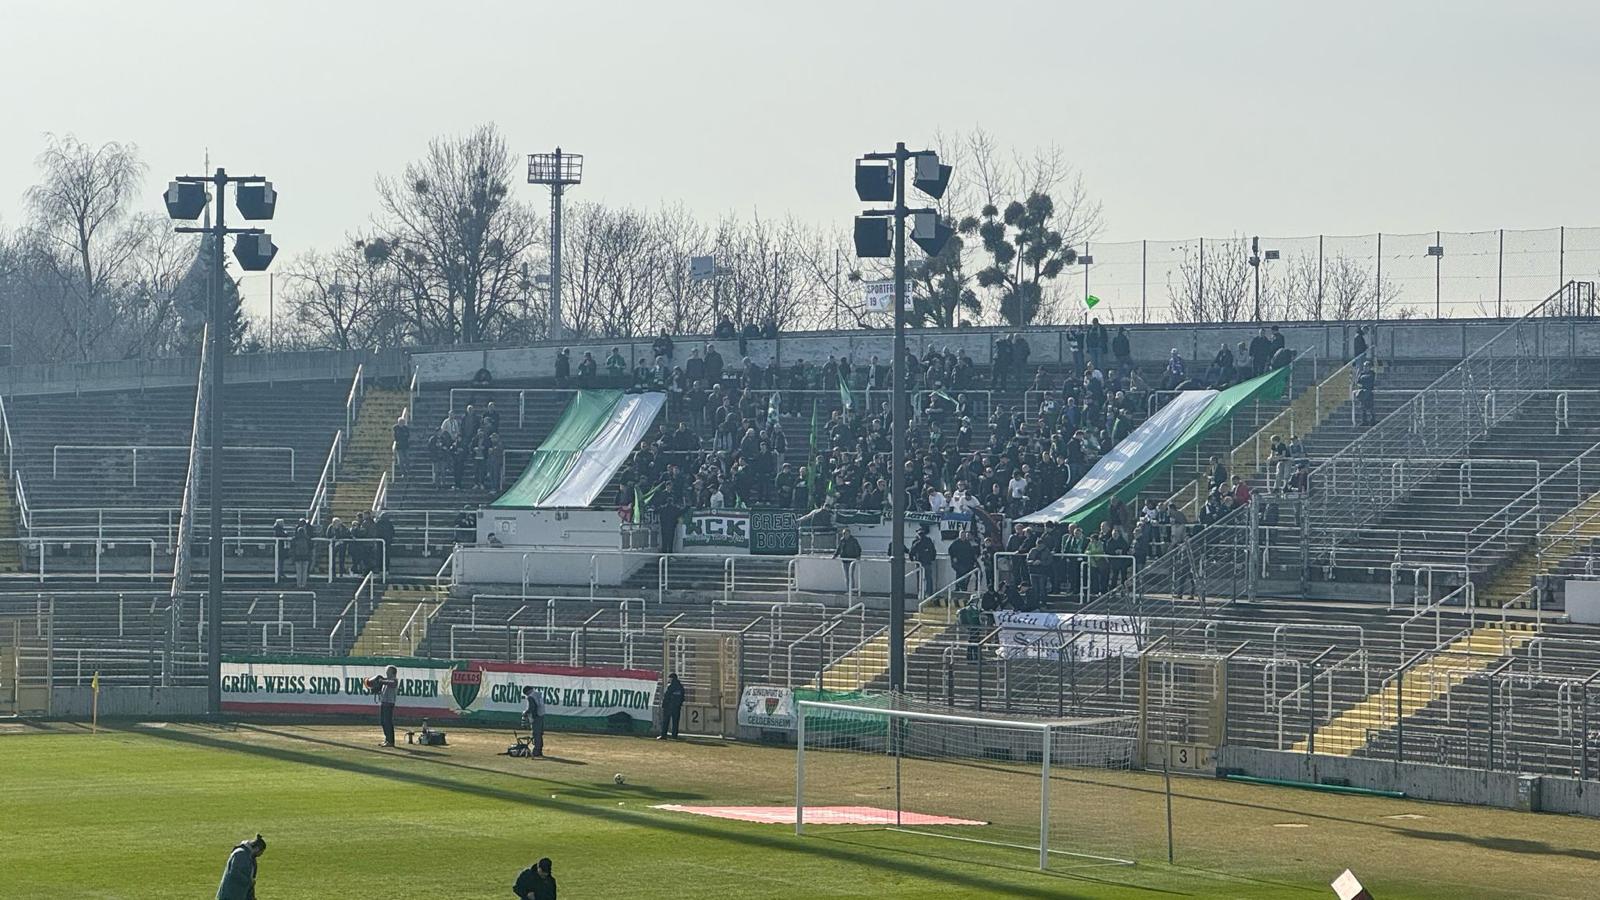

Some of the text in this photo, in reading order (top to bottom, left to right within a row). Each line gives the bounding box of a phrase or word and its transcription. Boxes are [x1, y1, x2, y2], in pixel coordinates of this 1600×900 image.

[751, 513, 800, 530] GREEN
[757, 532, 797, 548] BOYZ
[222, 673, 306, 694] GRÜN-WEISS
[309, 676, 340, 695] SIND
[397, 679, 438, 698] ARBEN
[563, 688, 585, 707] HAT
[588, 689, 650, 710] TRADITION
[692, 710, 699, 723] 2
[1179, 749, 1188, 763] 3
